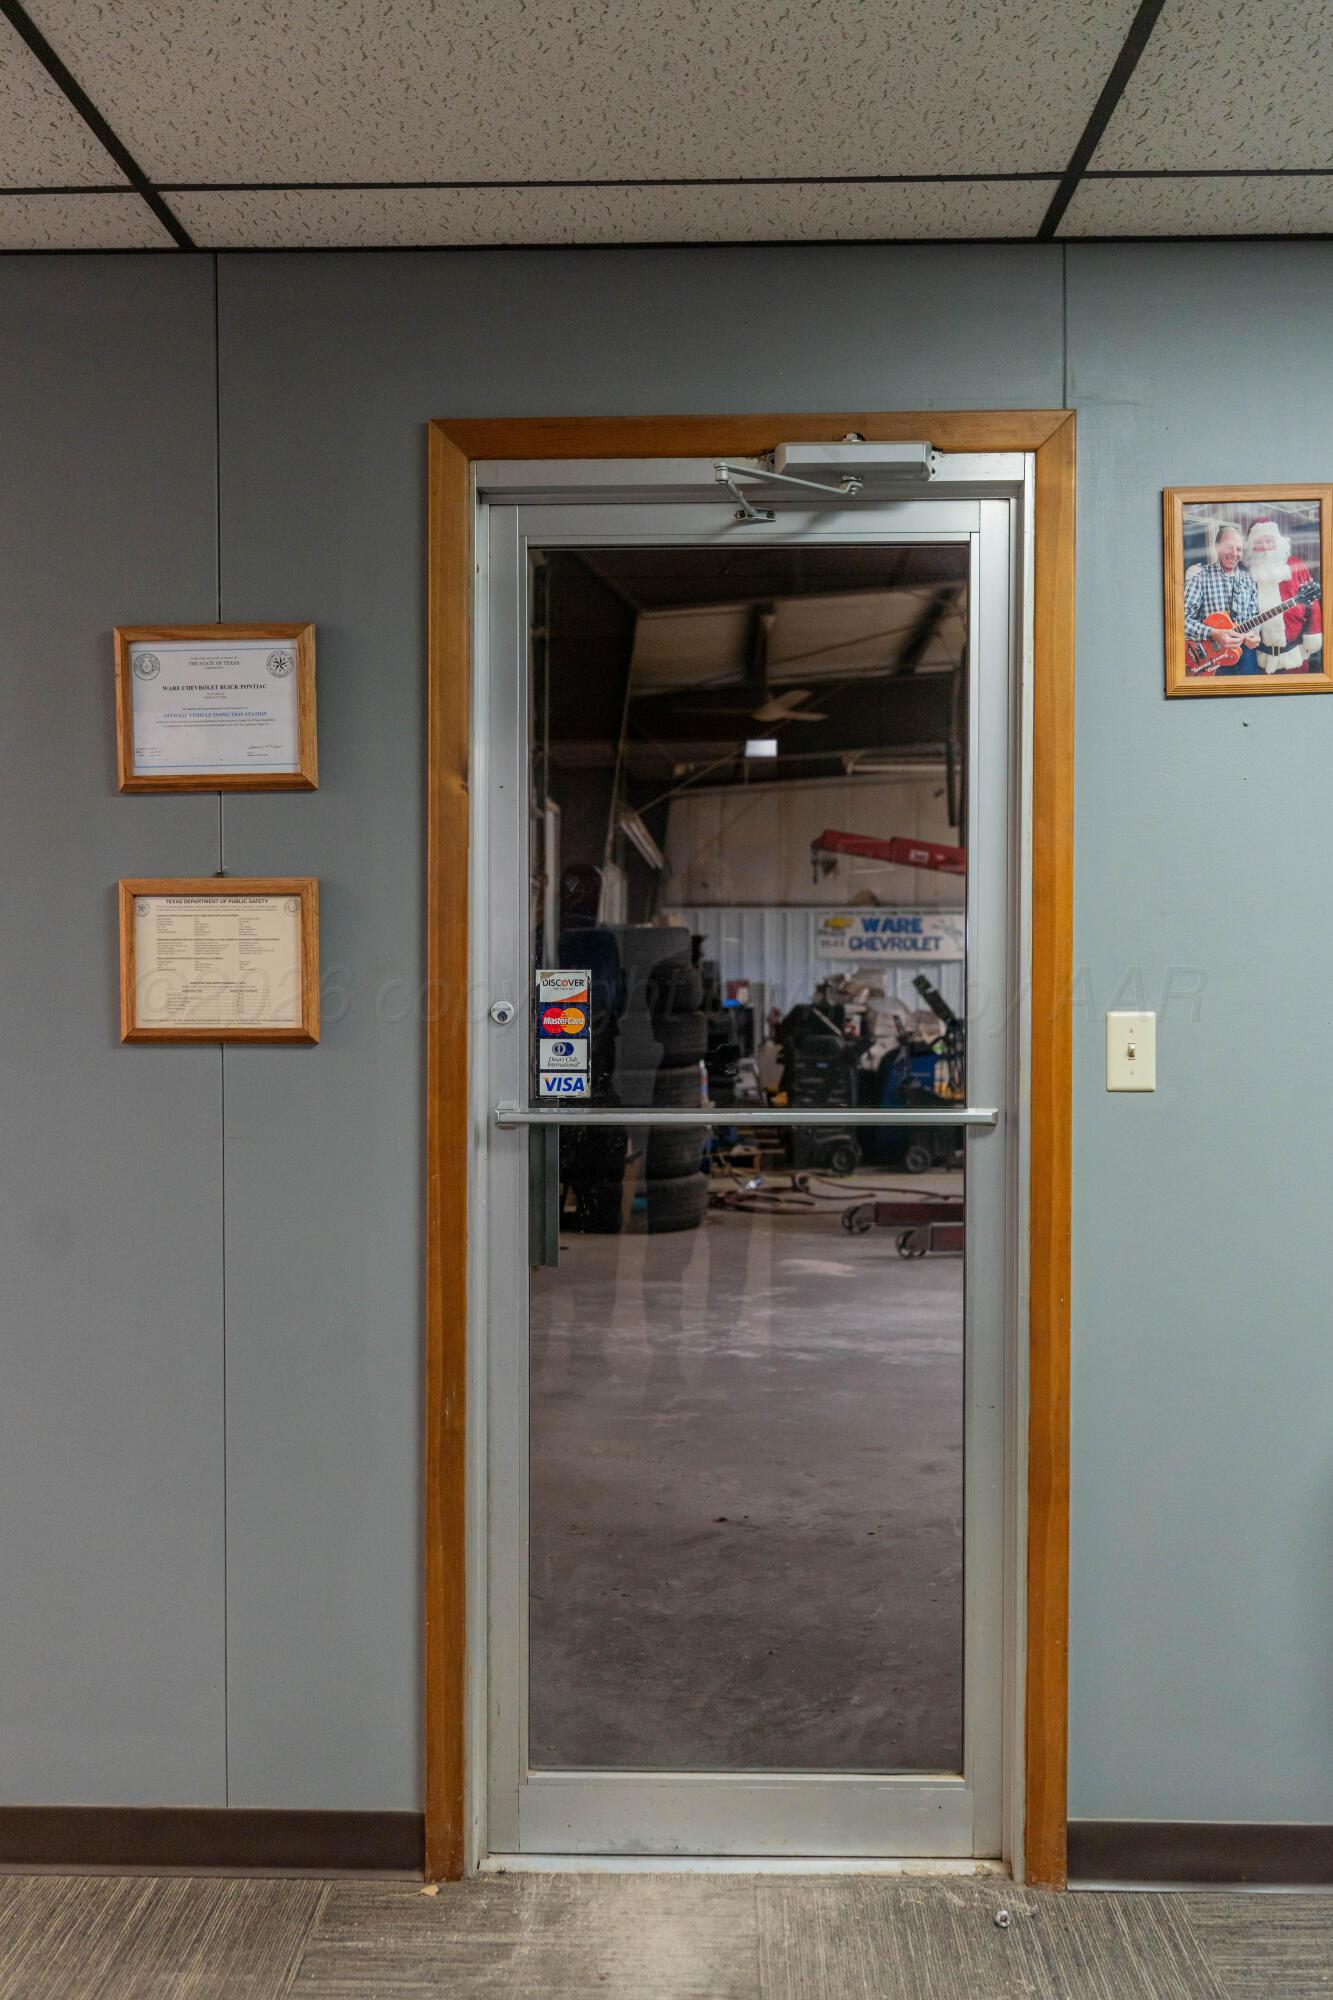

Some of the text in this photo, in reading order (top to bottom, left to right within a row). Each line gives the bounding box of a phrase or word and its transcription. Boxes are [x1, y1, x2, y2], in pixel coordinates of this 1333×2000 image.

[861, 916, 923, 934] WARE
[848, 936, 943, 951] CHEVROLET
[542, 979, 585, 988] DISCOVER
[543, 1016, 584, 1026] MasterCard
[545, 1076, 585, 1092] VISA
